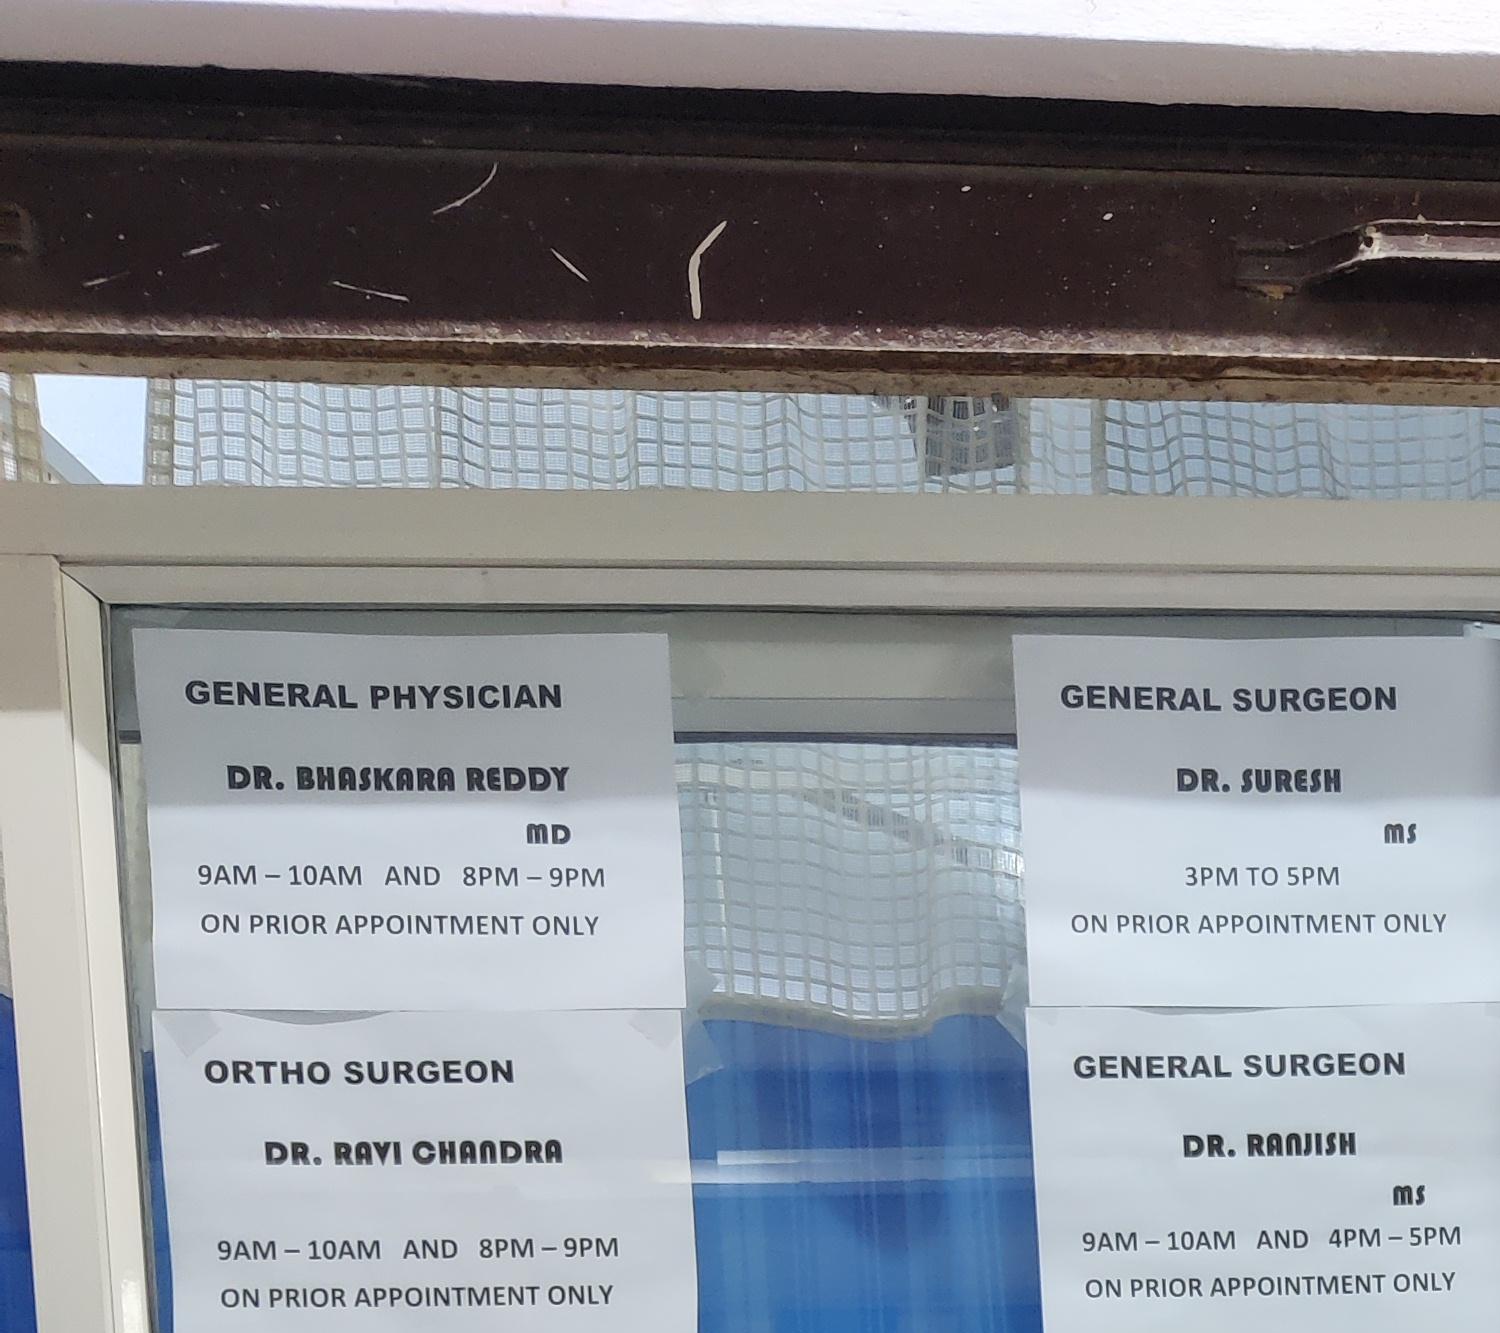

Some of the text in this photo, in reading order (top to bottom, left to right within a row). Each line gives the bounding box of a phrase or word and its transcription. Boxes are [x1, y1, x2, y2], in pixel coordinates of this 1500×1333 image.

[185, 681, 561, 709] GENERAL PHYSICIAN
[1061, 685, 1396, 712] GENERAL SURGEON
[227, 765, 569, 791] DR. BHASKARA REDDY
[1177, 768, 1341, 793] DR. SURESH
[527, 824, 571, 844] MD
[1384, 824, 1416, 844] MS
[1186, 867, 1339, 886] 3PM TO 5PM
[201, 914, 598, 935] ON PRIOR APPOINTMENT ONLY
[205, 1060, 513, 1084] ORTHO SURGEON
[1074, 1053, 1405, 1079] GENERAL SURGEON
[265, 1140, 562, 1165] DR. RAVI CHANDRA
[1183, 1132, 1356, 1157] DR. RANJISH
[1393, 1185, 1425, 1205] MS
